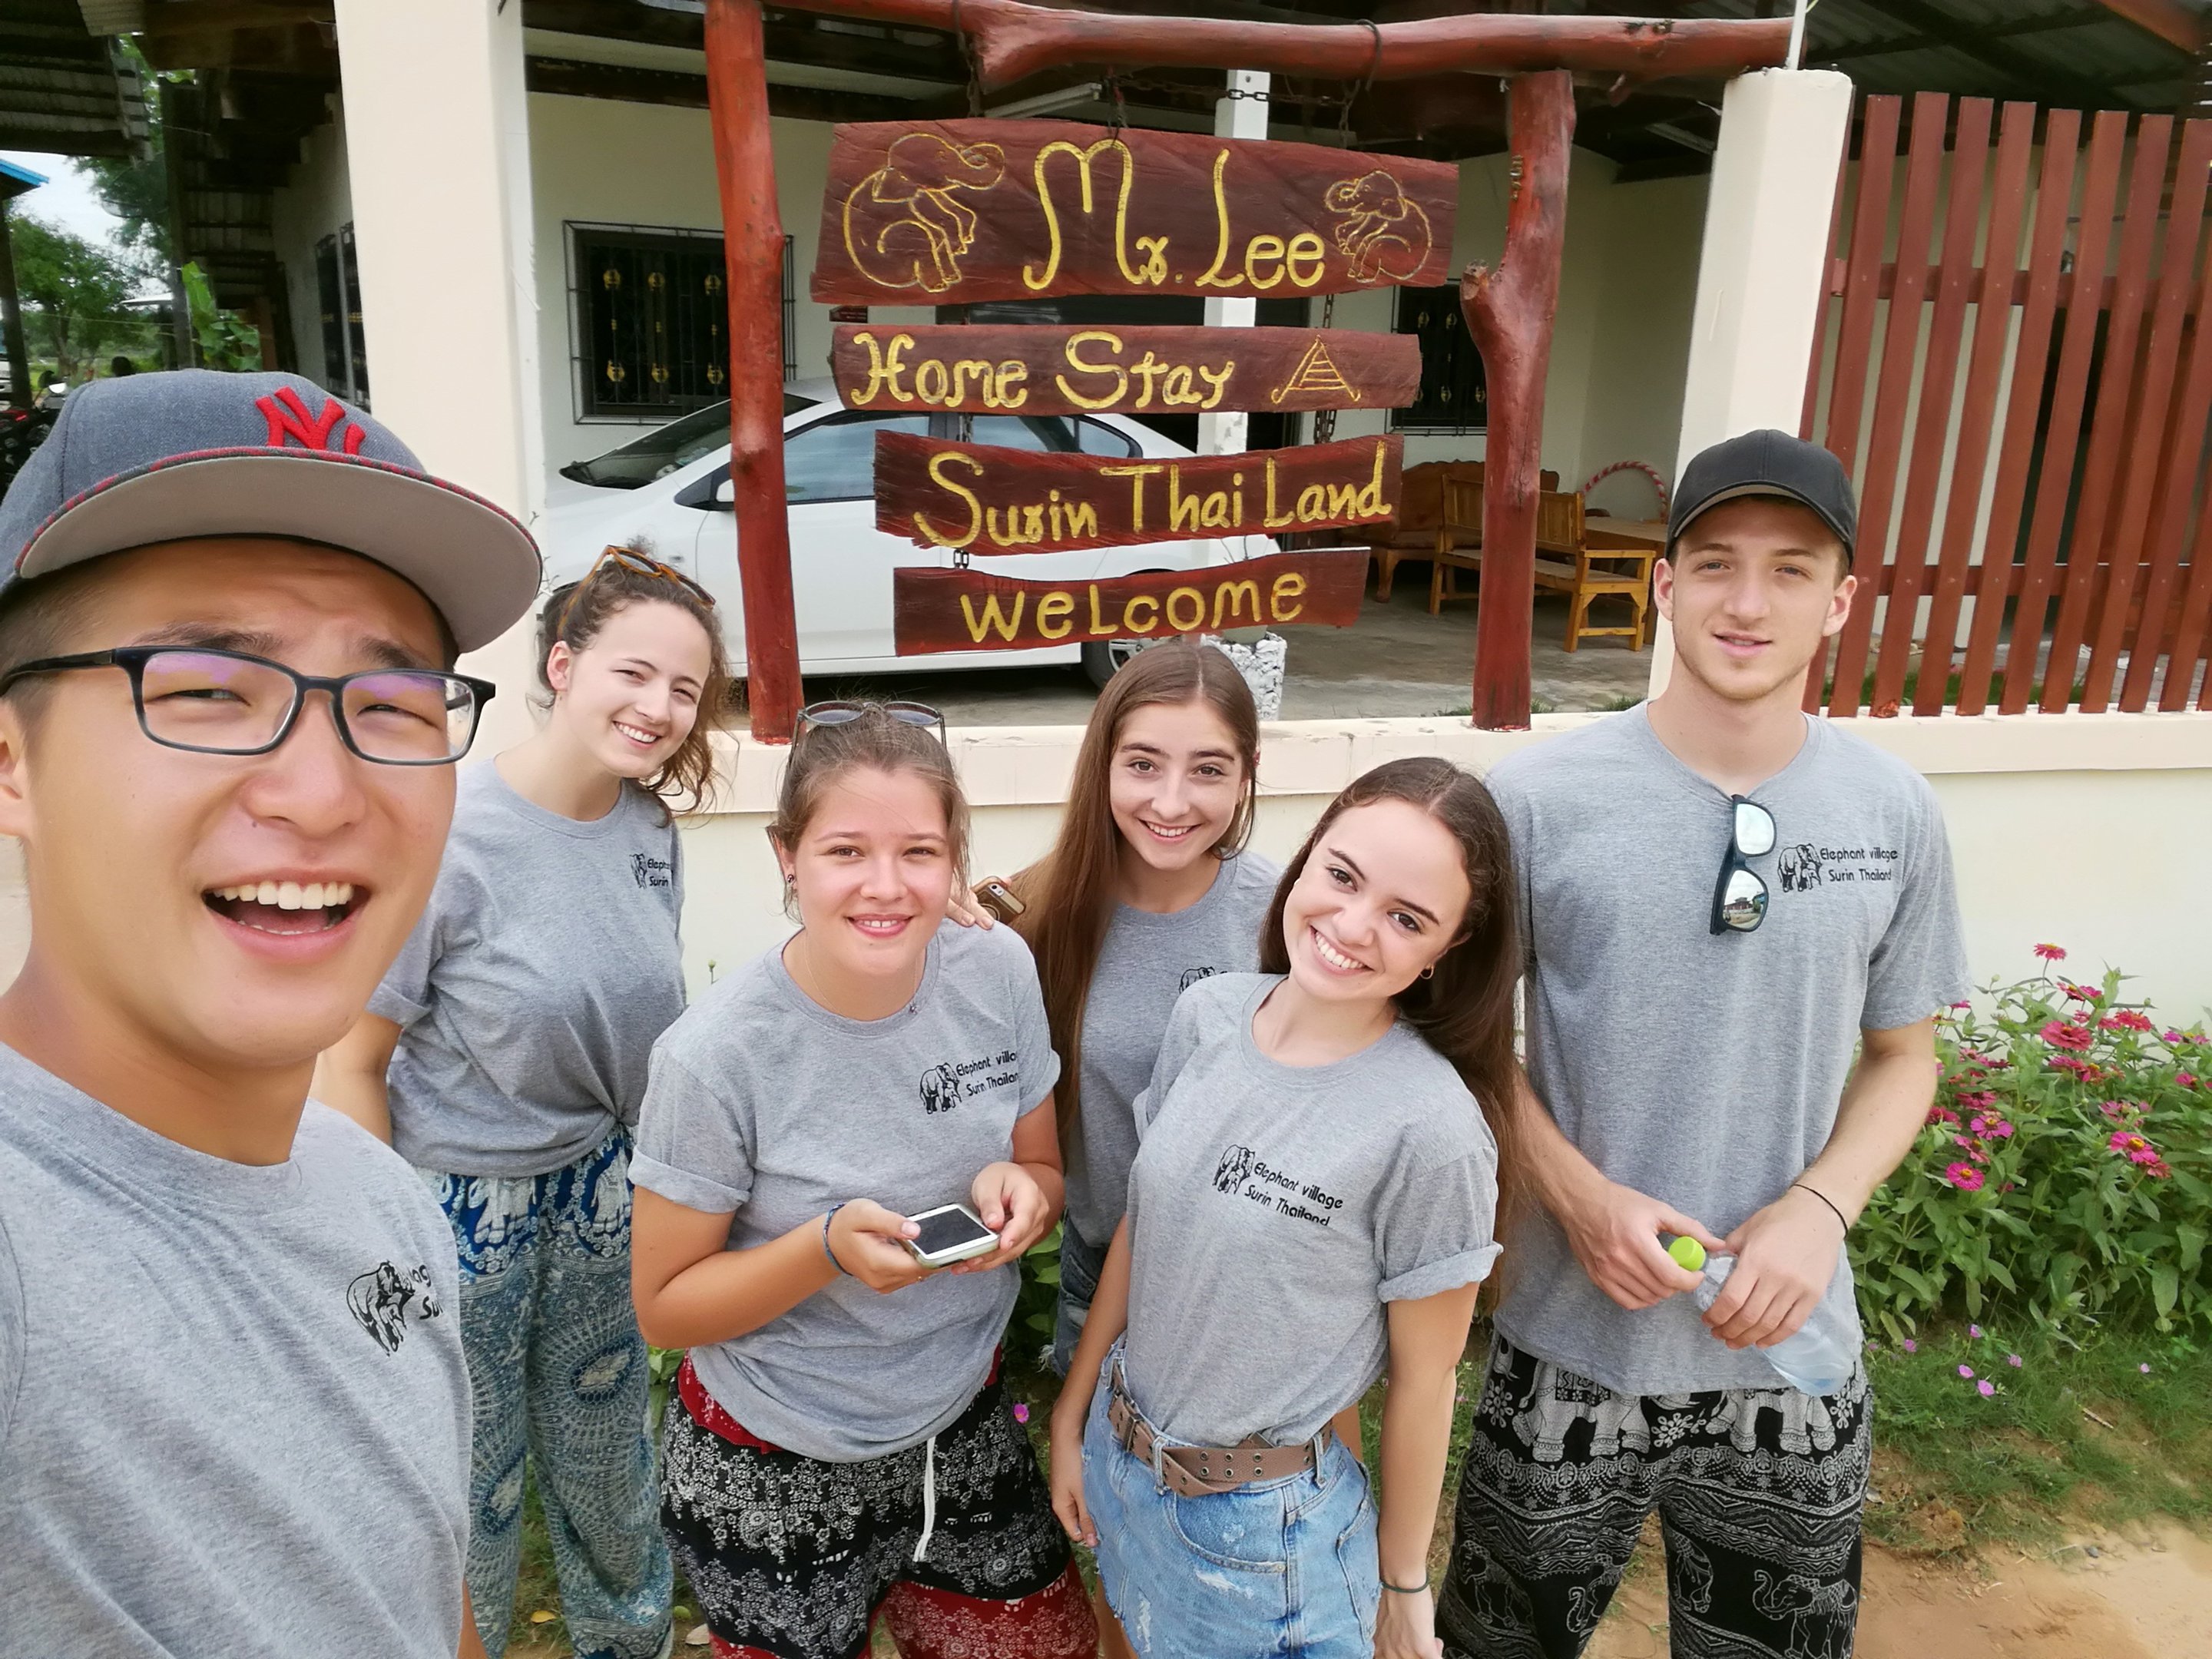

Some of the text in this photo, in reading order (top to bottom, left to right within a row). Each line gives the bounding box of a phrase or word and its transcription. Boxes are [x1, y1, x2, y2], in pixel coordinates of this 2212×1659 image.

[1022, 138, 1326, 290] Mr. Lee
[849, 330, 1234, 410] Home Stay
[913, 451, 1098, 548] Surin
[1820, 846, 1899, 864] Elephant village
[649, 876, 669, 887] Surin
[1828, 868, 1892, 882] Surin Thailand
[955, 1056, 992, 1077] Elephant
[965, 1080, 987, 1097] Surin
[1253, 1161, 1344, 1210] Elephant village
[1243, 1184, 1331, 1227] Surin Thailand
